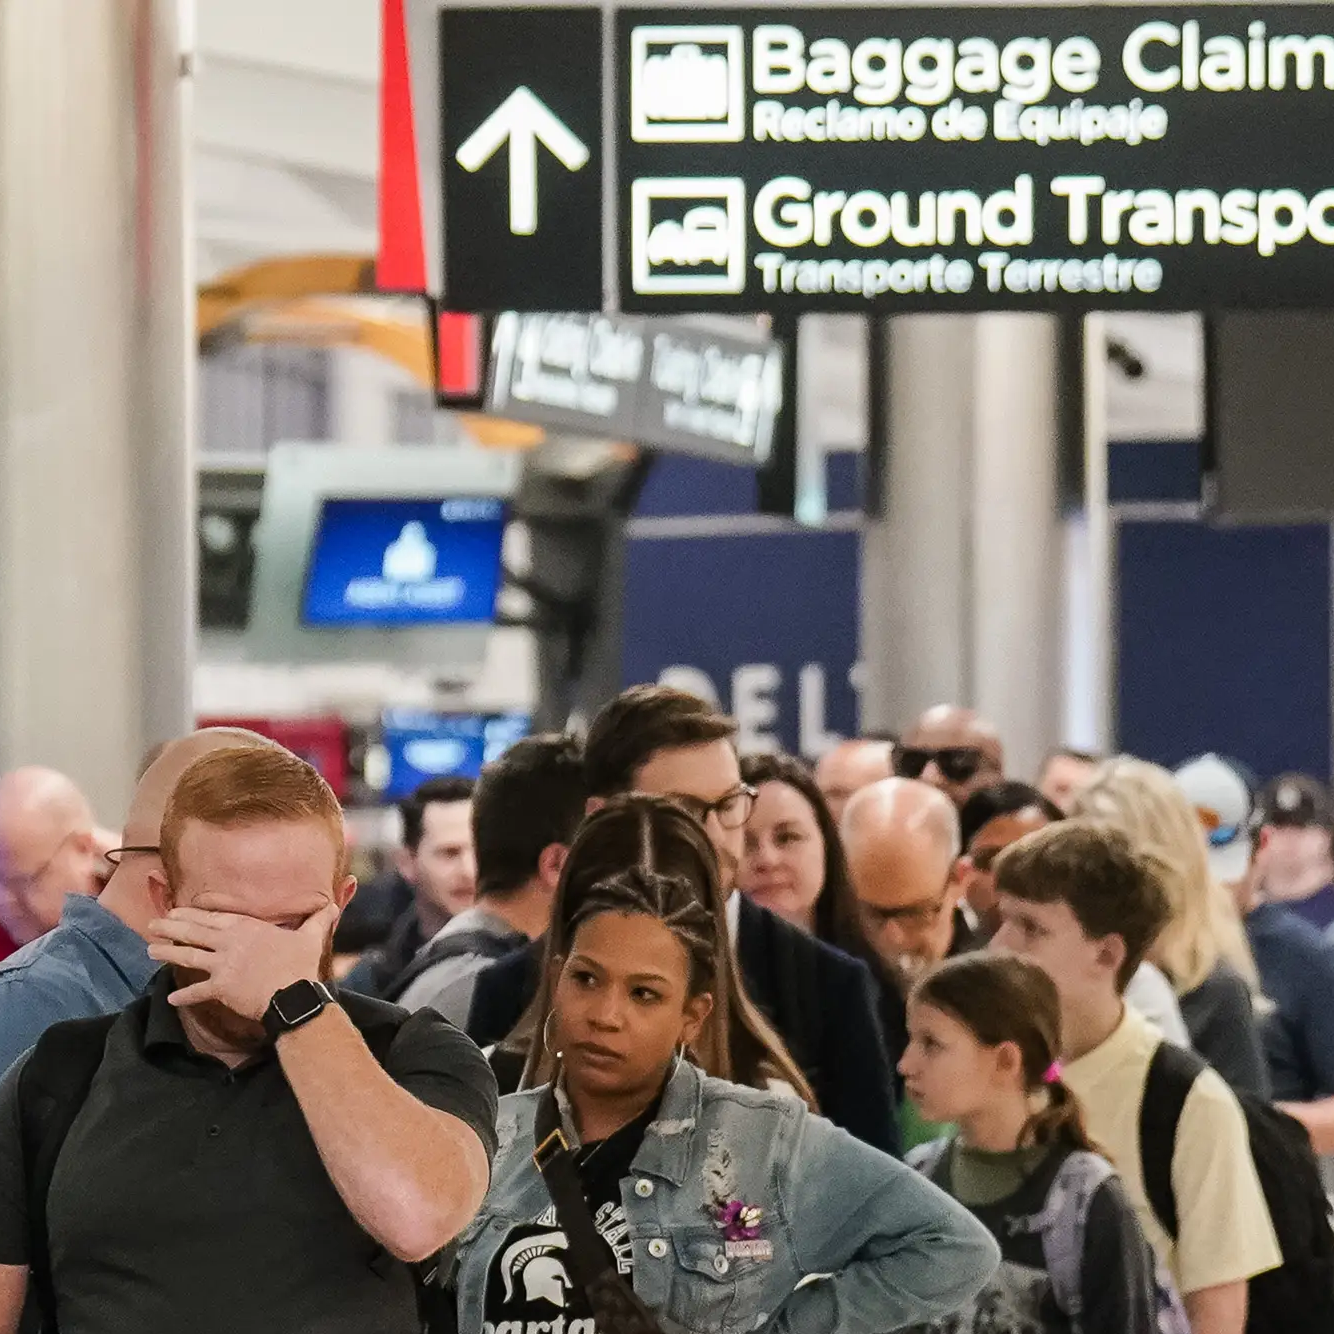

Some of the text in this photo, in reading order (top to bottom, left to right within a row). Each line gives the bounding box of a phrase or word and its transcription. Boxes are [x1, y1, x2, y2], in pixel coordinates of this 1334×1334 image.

[752, 23, 1101, 105] Baggage
[753, 98, 1168, 146] Reclamo de Equipaje
[753, 173, 1035, 248] Ground
[754, 251, 1163, 299] Transporte Terrestre
